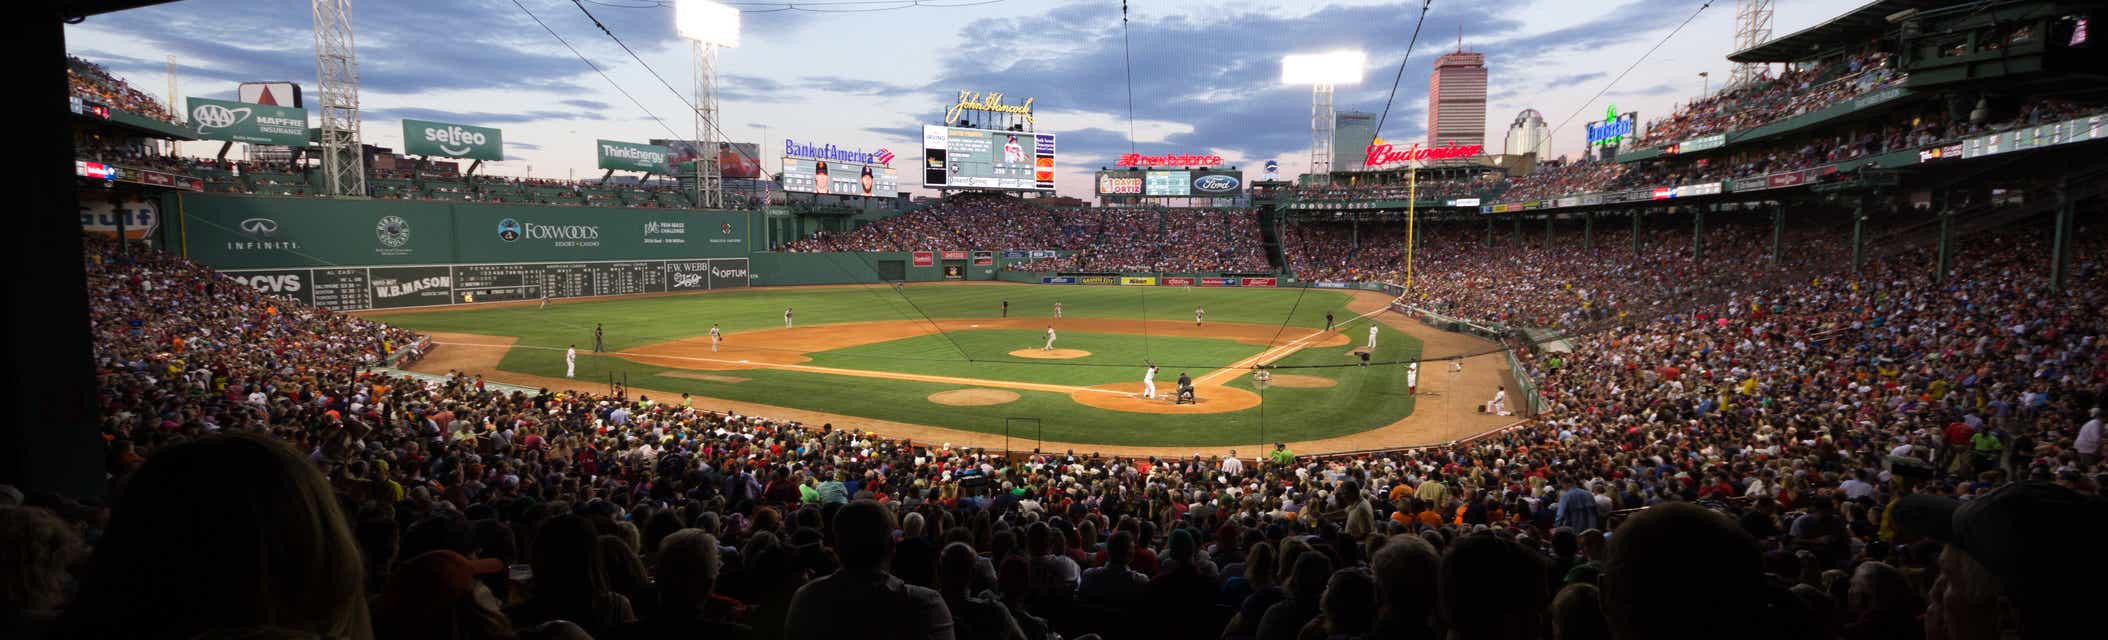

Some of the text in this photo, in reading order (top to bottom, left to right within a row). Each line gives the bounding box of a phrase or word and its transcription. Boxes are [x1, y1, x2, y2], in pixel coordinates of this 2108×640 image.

[946, 89, 1035, 124] John Hancock
[200, 106, 228, 126] AAA
[256, 116, 304, 127] MAPFRE
[260, 126, 302, 135] INSURANCE
[1365, 140, 1482, 166] Budweiser
[1141, 155, 1165, 166] new
[1167, 153, 1221, 166] balance
[1202, 178, 1230, 189] Ford
[683, 262, 708, 271] WEBB
[720, 268, 746, 278] OPTUM
[250, 274, 300, 292] CVS
